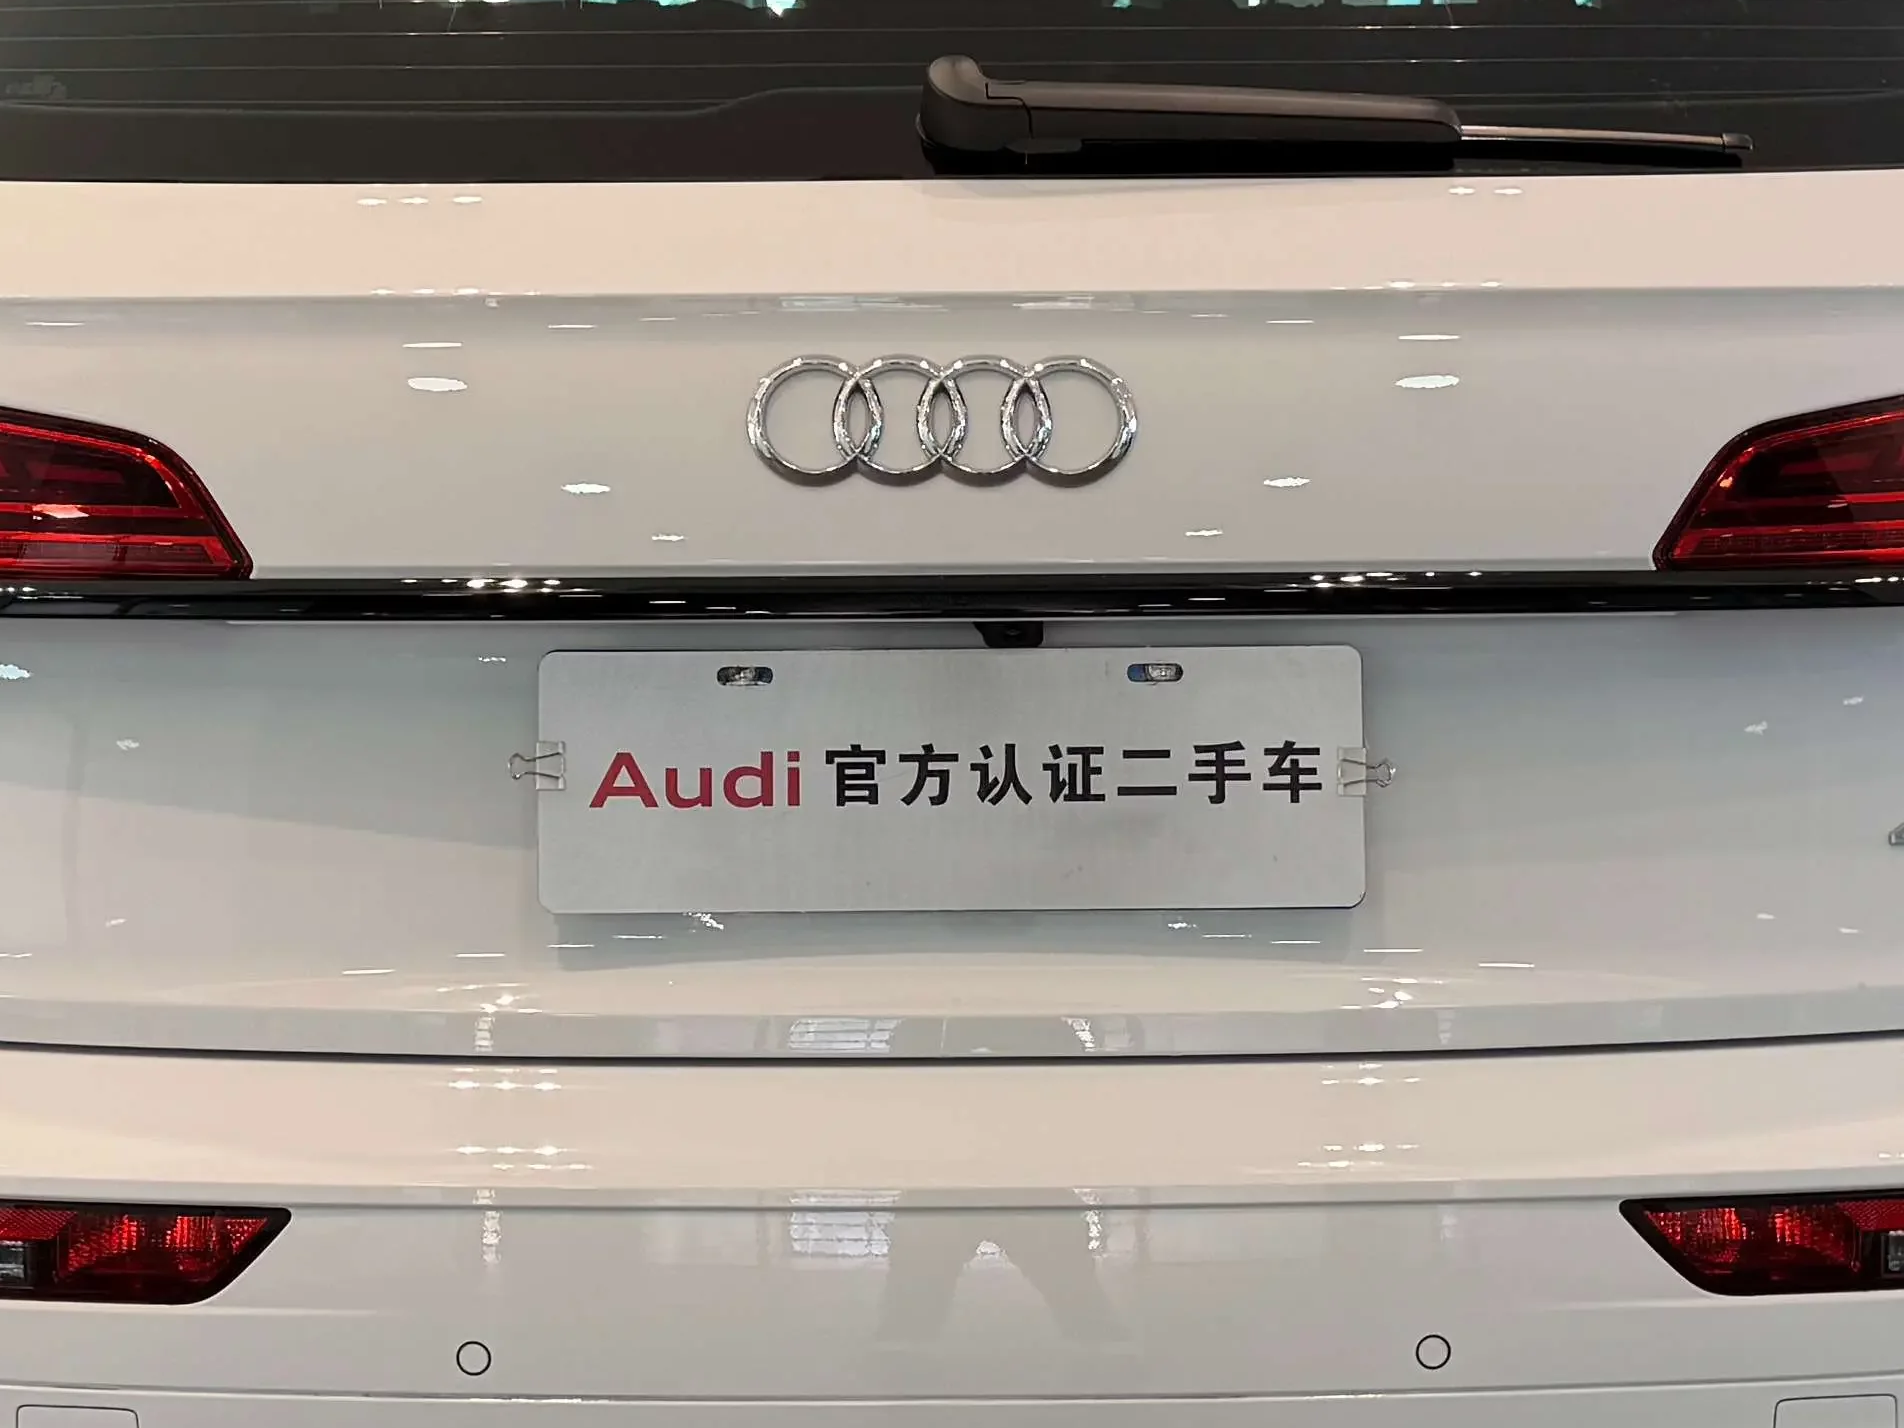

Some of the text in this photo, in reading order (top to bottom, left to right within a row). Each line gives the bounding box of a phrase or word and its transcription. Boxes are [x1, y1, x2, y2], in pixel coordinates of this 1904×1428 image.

[588, 740, 1325, 809] Audi 官方认证二手车
